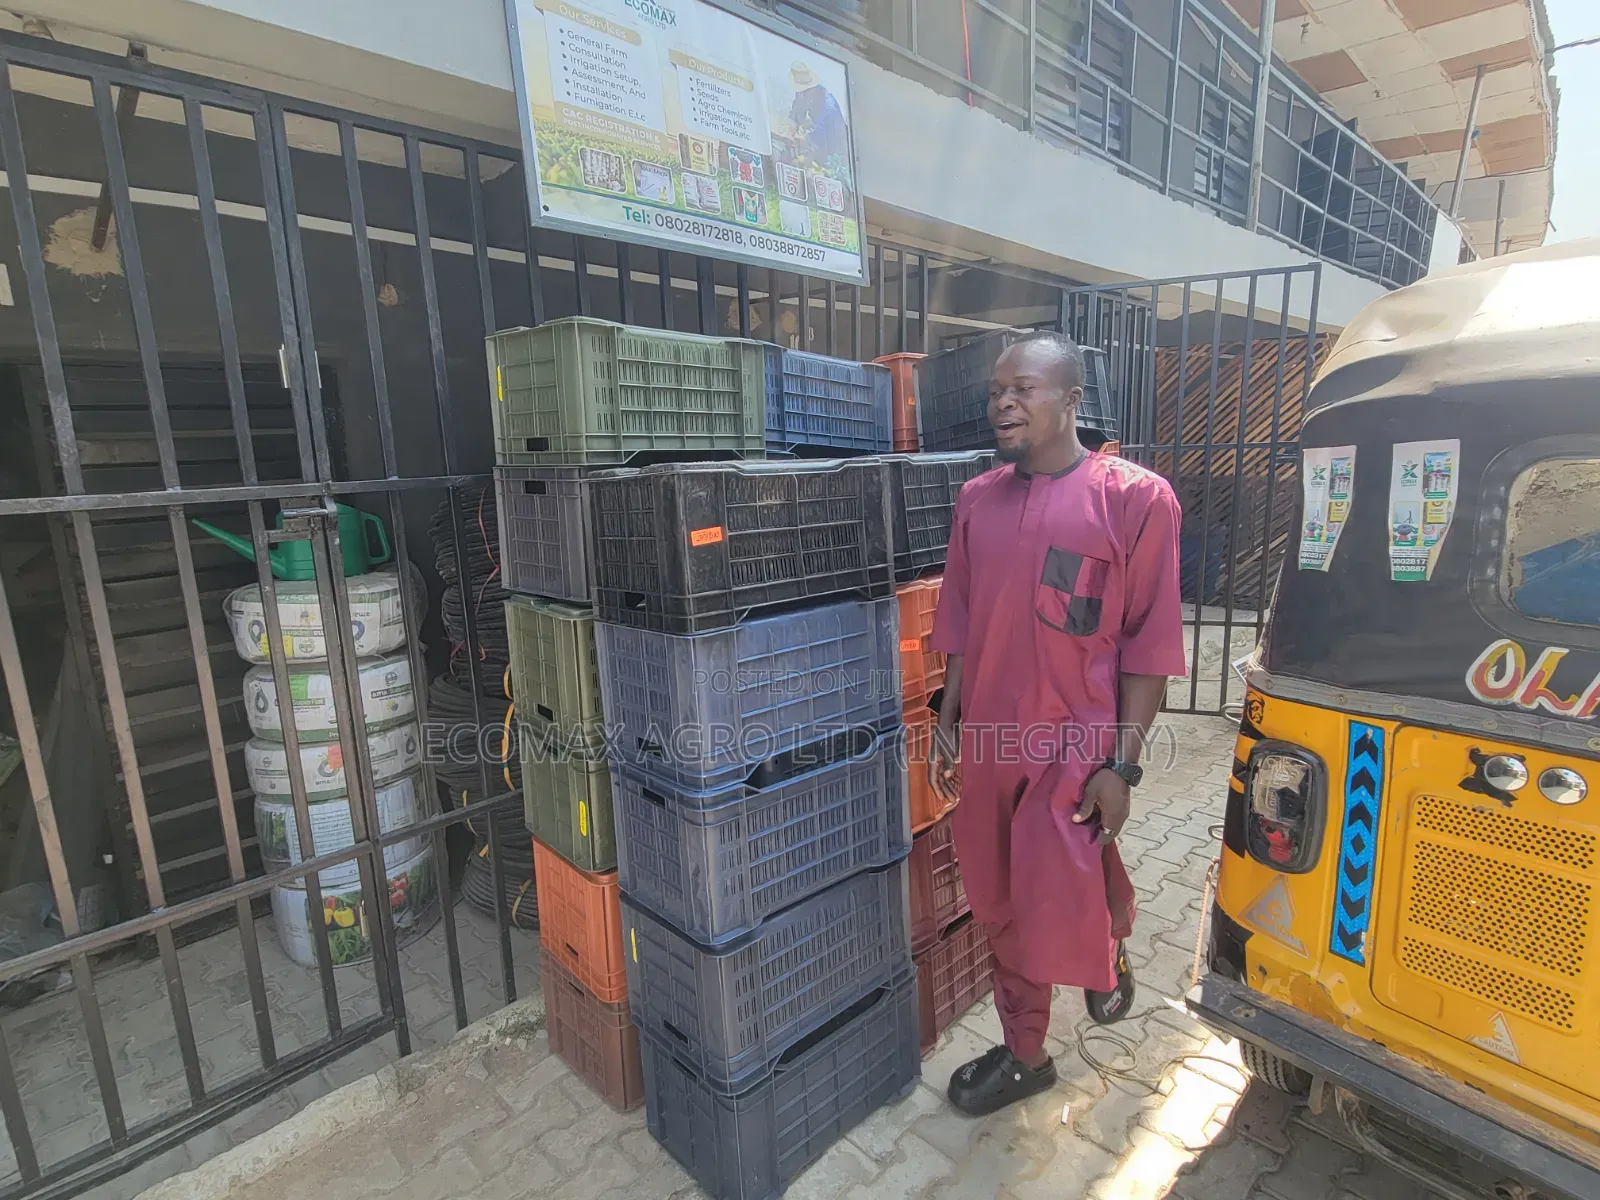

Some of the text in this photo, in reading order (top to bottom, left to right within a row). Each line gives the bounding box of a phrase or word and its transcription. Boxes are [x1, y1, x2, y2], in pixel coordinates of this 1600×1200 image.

[559, 4, 627, 39] Our Services
[567, 30, 628, 59] General Farm
[568, 43, 626, 69] Consultation
[570, 55, 641, 87] Irrigation Setup,
[688, 60, 705, 72] Our
[571, 68, 646, 99] Assessment, And
[573, 80, 623, 102] Installation
[696, 78, 731, 97] Fertilizers
[697, 88, 719, 102] Seeds
[574, 93, 626, 115] Fumigation
[698, 98, 753, 124] Agro Chemicals
[562, 108, 585, 120] CAC
[585, 114, 652, 140] REGISTRATION
[563, 119, 581, 128] POST
[700, 108, 747, 130] Irrigation Kits
[700, 118, 719, 131] Farm
[622, 206, 826, 262] Tel: 08028172818, 08038872857
